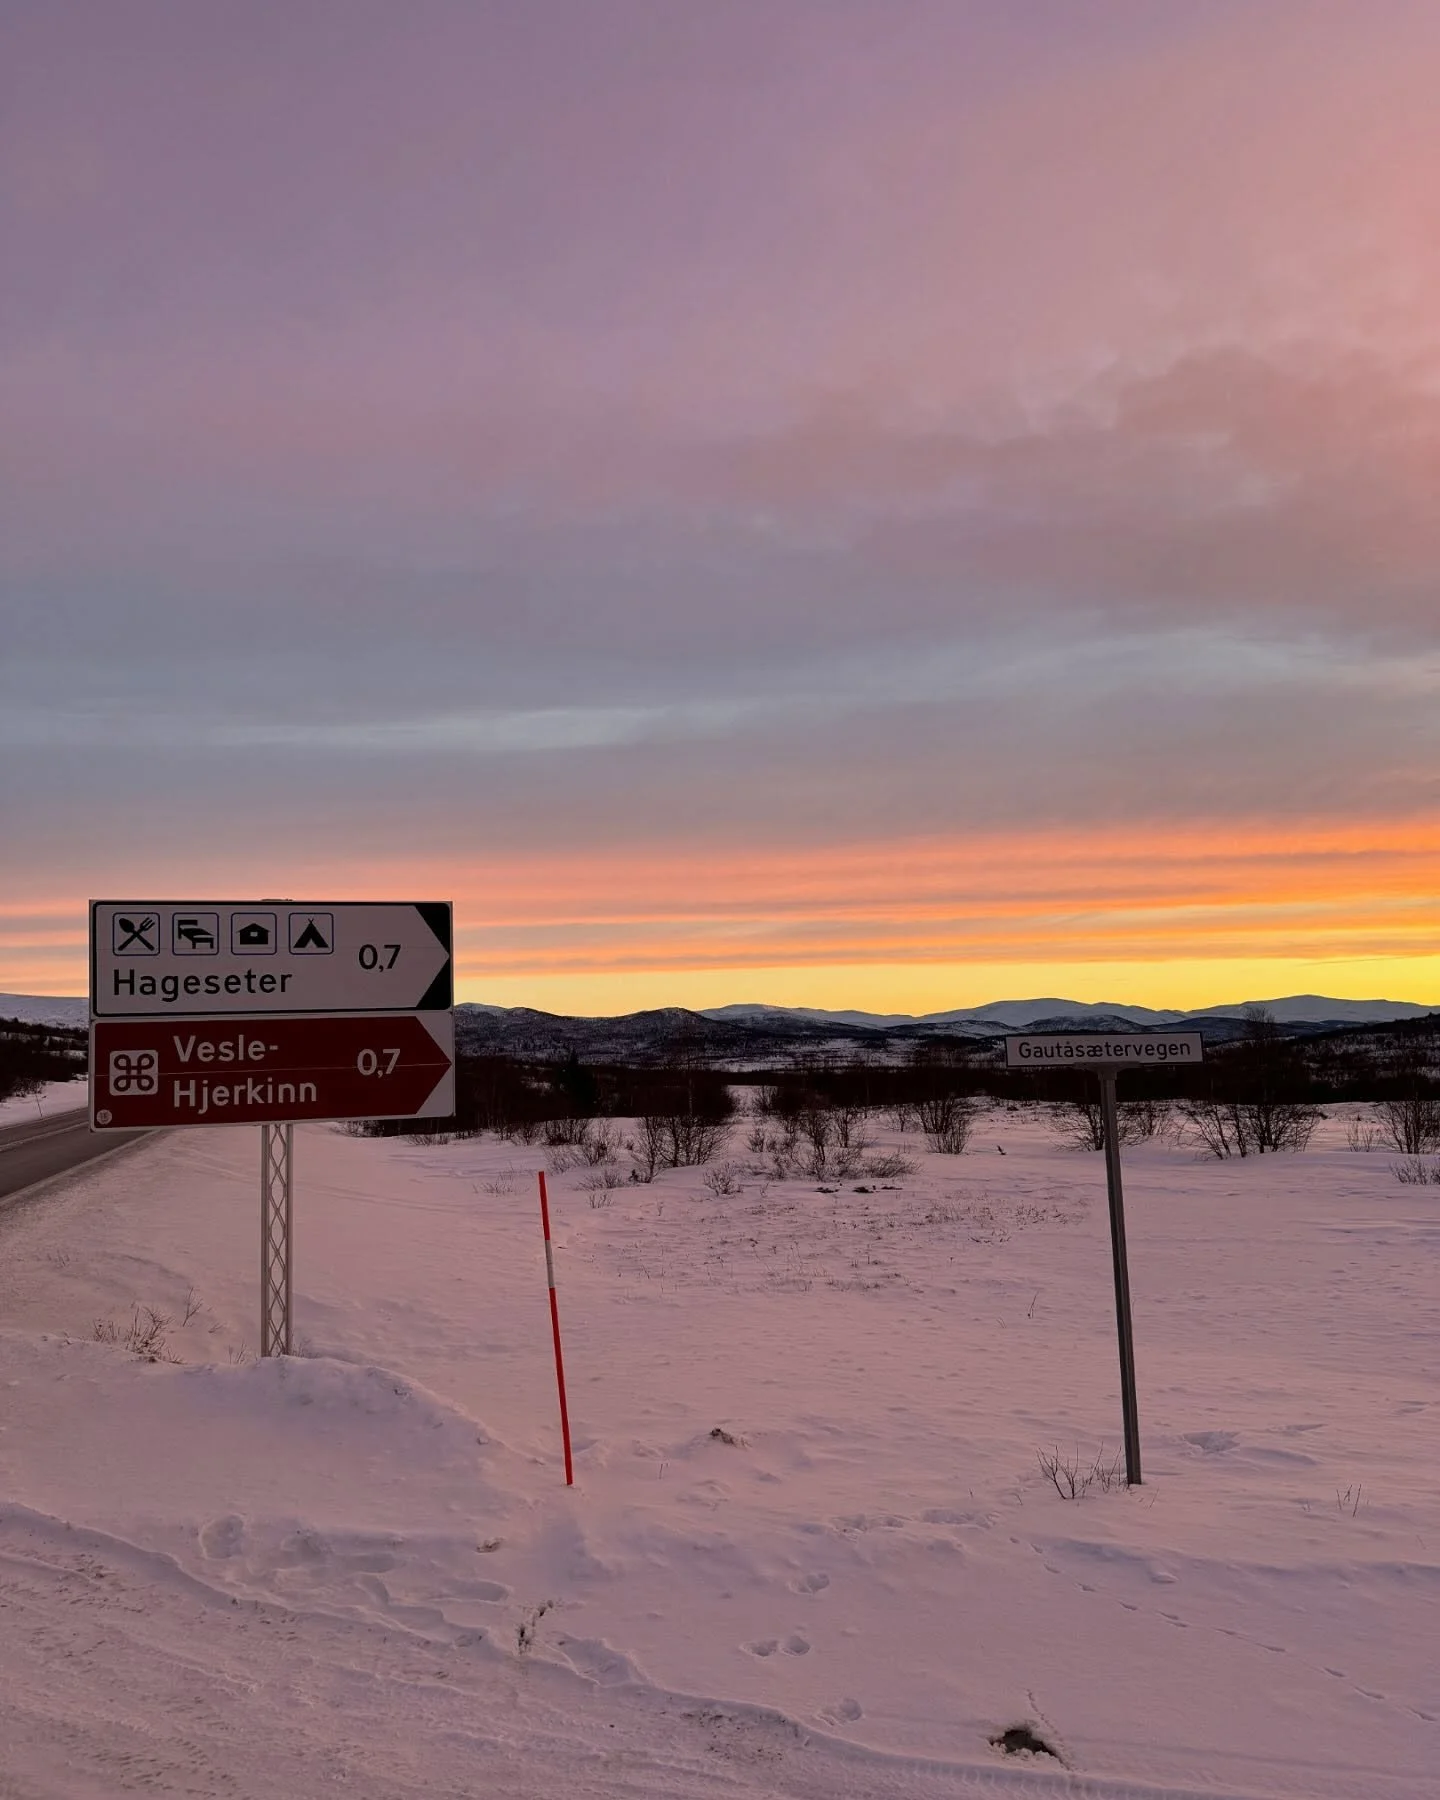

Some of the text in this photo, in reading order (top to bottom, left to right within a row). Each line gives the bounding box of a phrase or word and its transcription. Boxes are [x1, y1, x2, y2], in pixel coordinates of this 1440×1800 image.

[358, 944, 402, 973] 0,7
[113, 968, 292, 1003] Hageseter
[173, 1034, 279, 1063] Vesle-
[356, 1048, 401, 1078] 0,7
[1018, 1040, 1191, 1060] Gautåsætervegen
[173, 1077, 317, 1115] Hjerkinn
